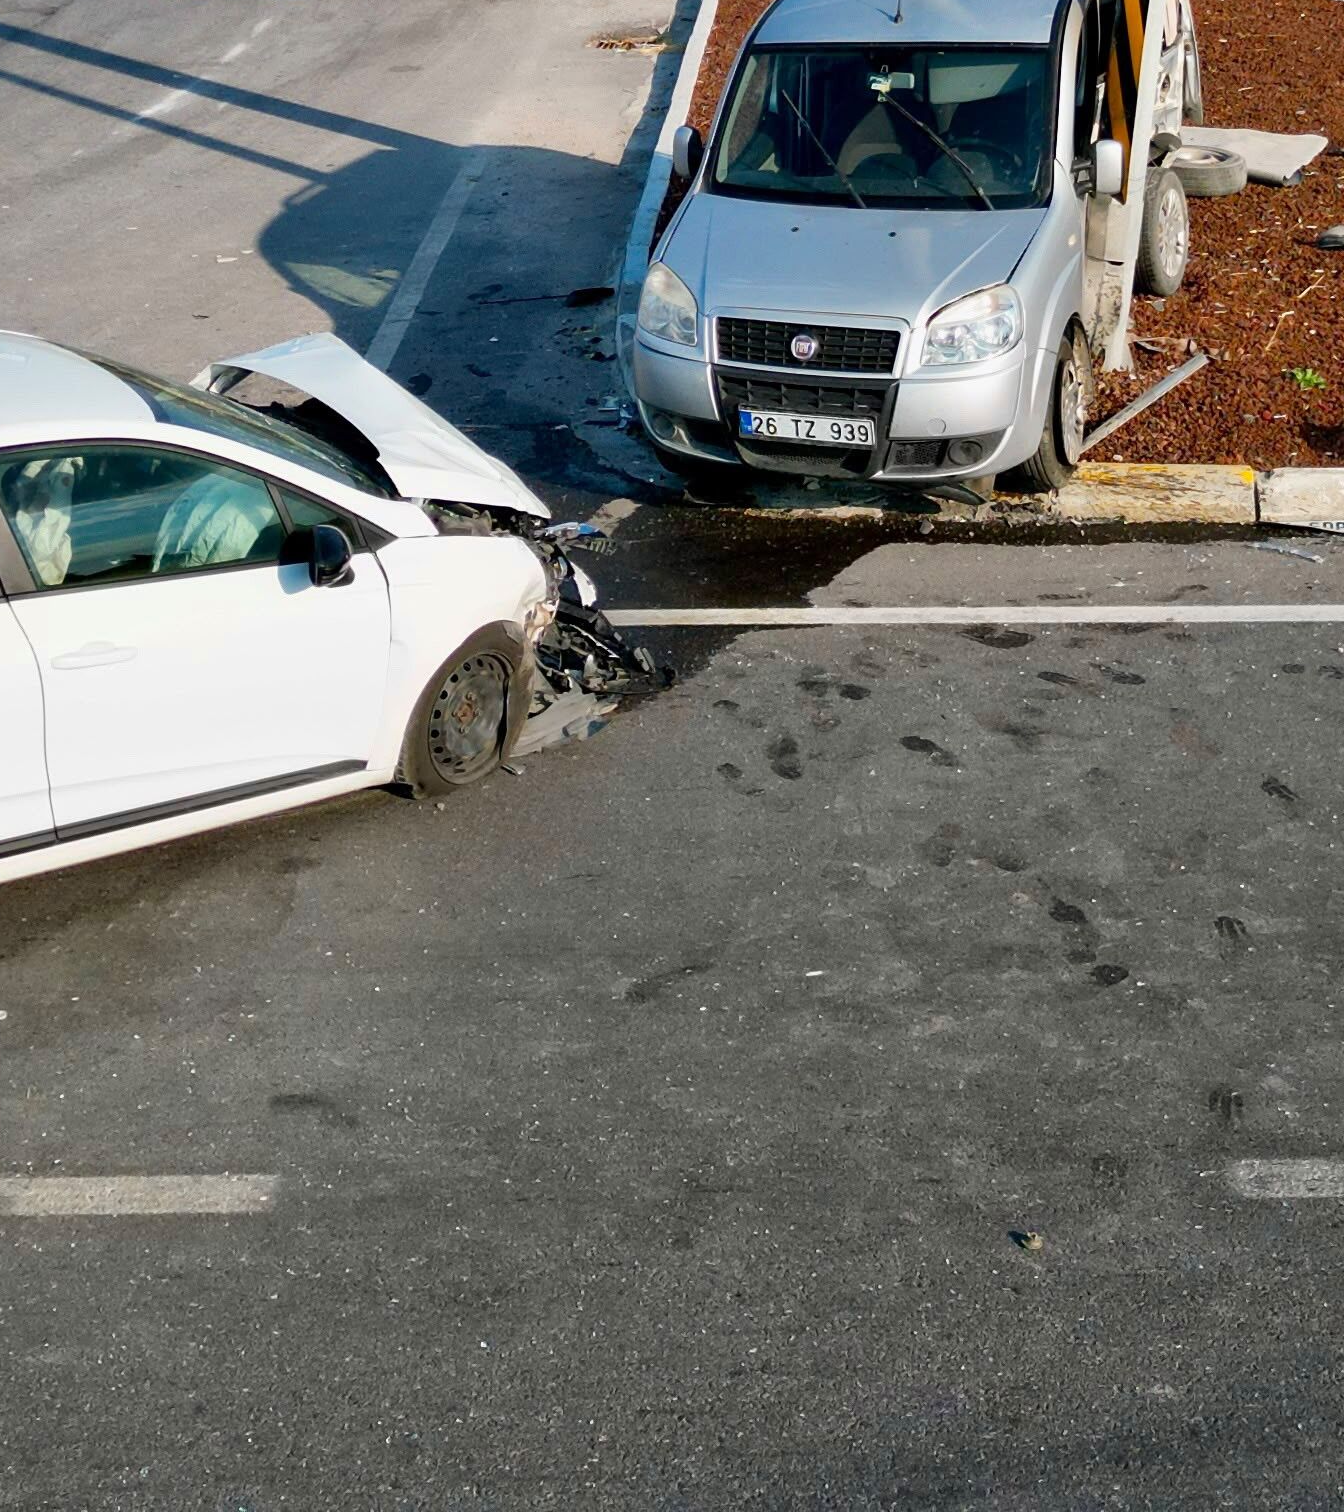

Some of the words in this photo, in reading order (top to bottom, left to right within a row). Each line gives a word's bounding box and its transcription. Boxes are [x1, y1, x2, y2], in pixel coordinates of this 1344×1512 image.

[753, 416, 778, 435] 26
[790, 418, 817, 439] TZ
[830, 422, 869, 443] 939
